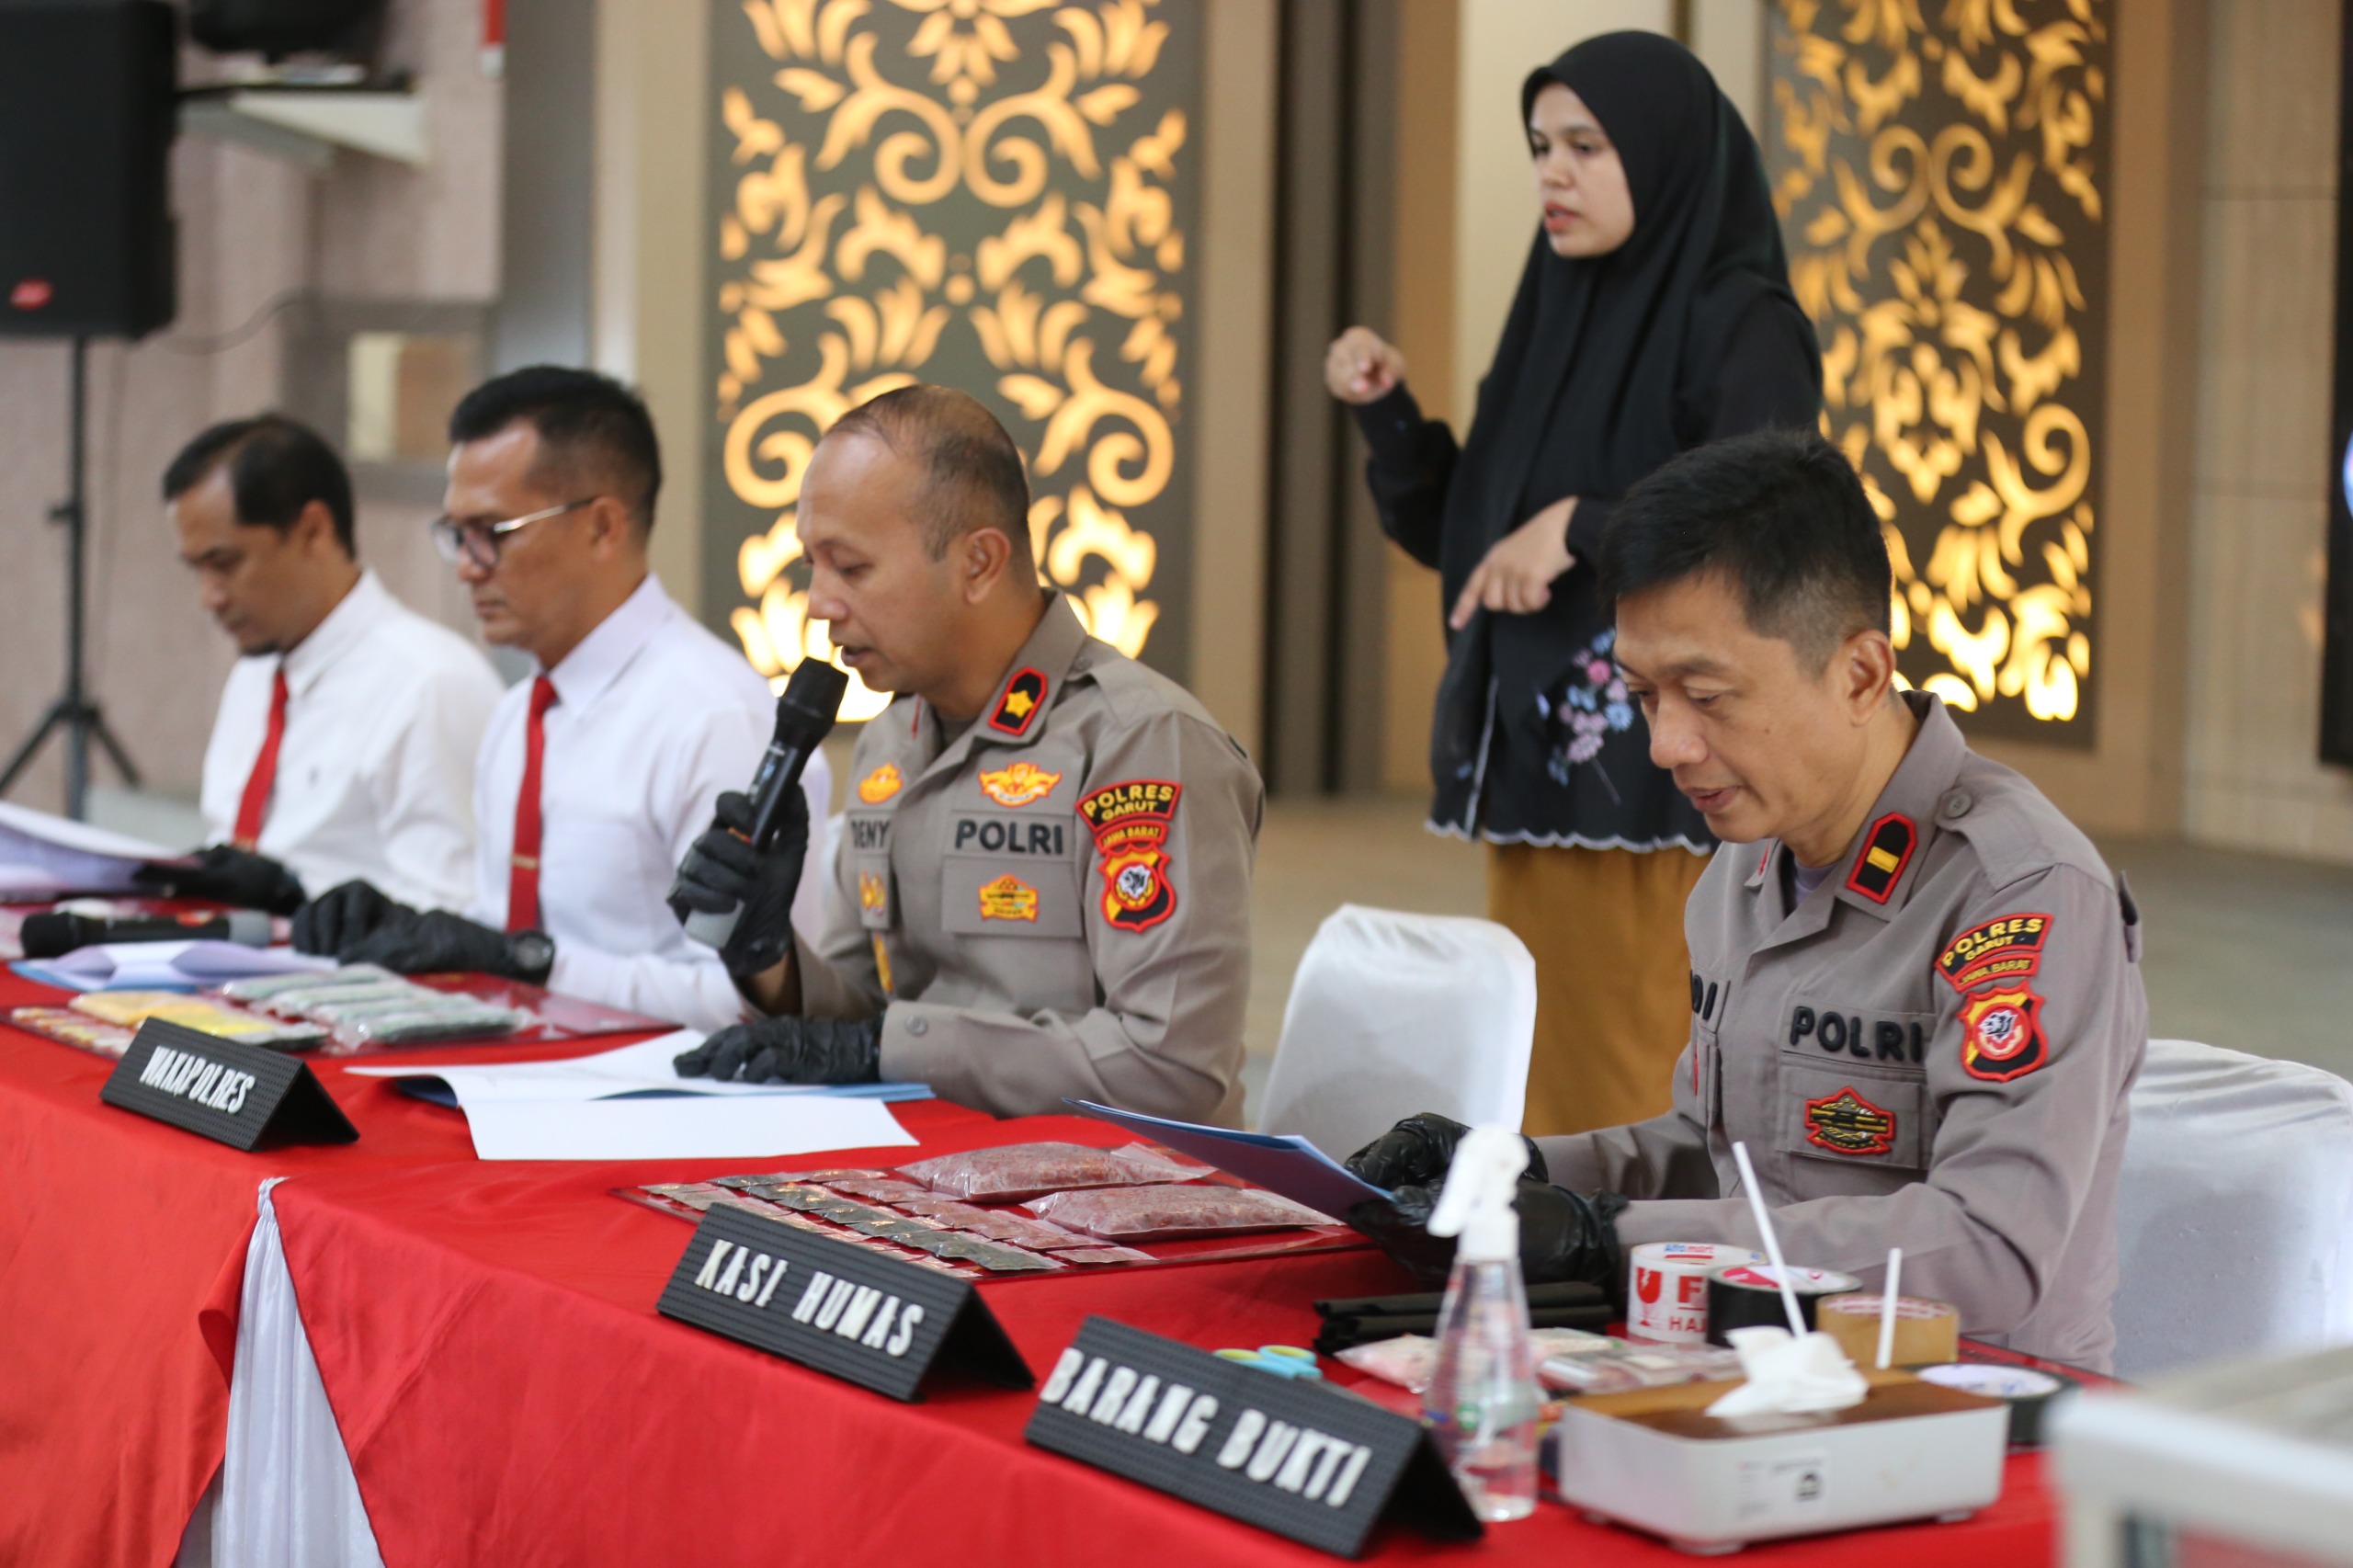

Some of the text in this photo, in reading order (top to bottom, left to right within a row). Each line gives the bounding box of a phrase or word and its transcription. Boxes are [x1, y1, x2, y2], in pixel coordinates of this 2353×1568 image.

[1083, 784, 1174, 818] POLRES
[1101, 801, 1158, 822] GARUT
[955, 819, 1063, 855] POLRI
[1127, 826, 1160, 839] BARAT
[1942, 918, 2043, 967] POLRES
[1964, 935, 2015, 961] GARUT
[1991, 959, 2031, 973] BARAT
[1789, 1006, 1924, 1063] POLRI
[139, 1045, 256, 1114] WAKAPOLRES
[695, 1239, 925, 1358] KASI HUMAS
[1039, 1347, 1372, 1507] BARANG BUKTI
